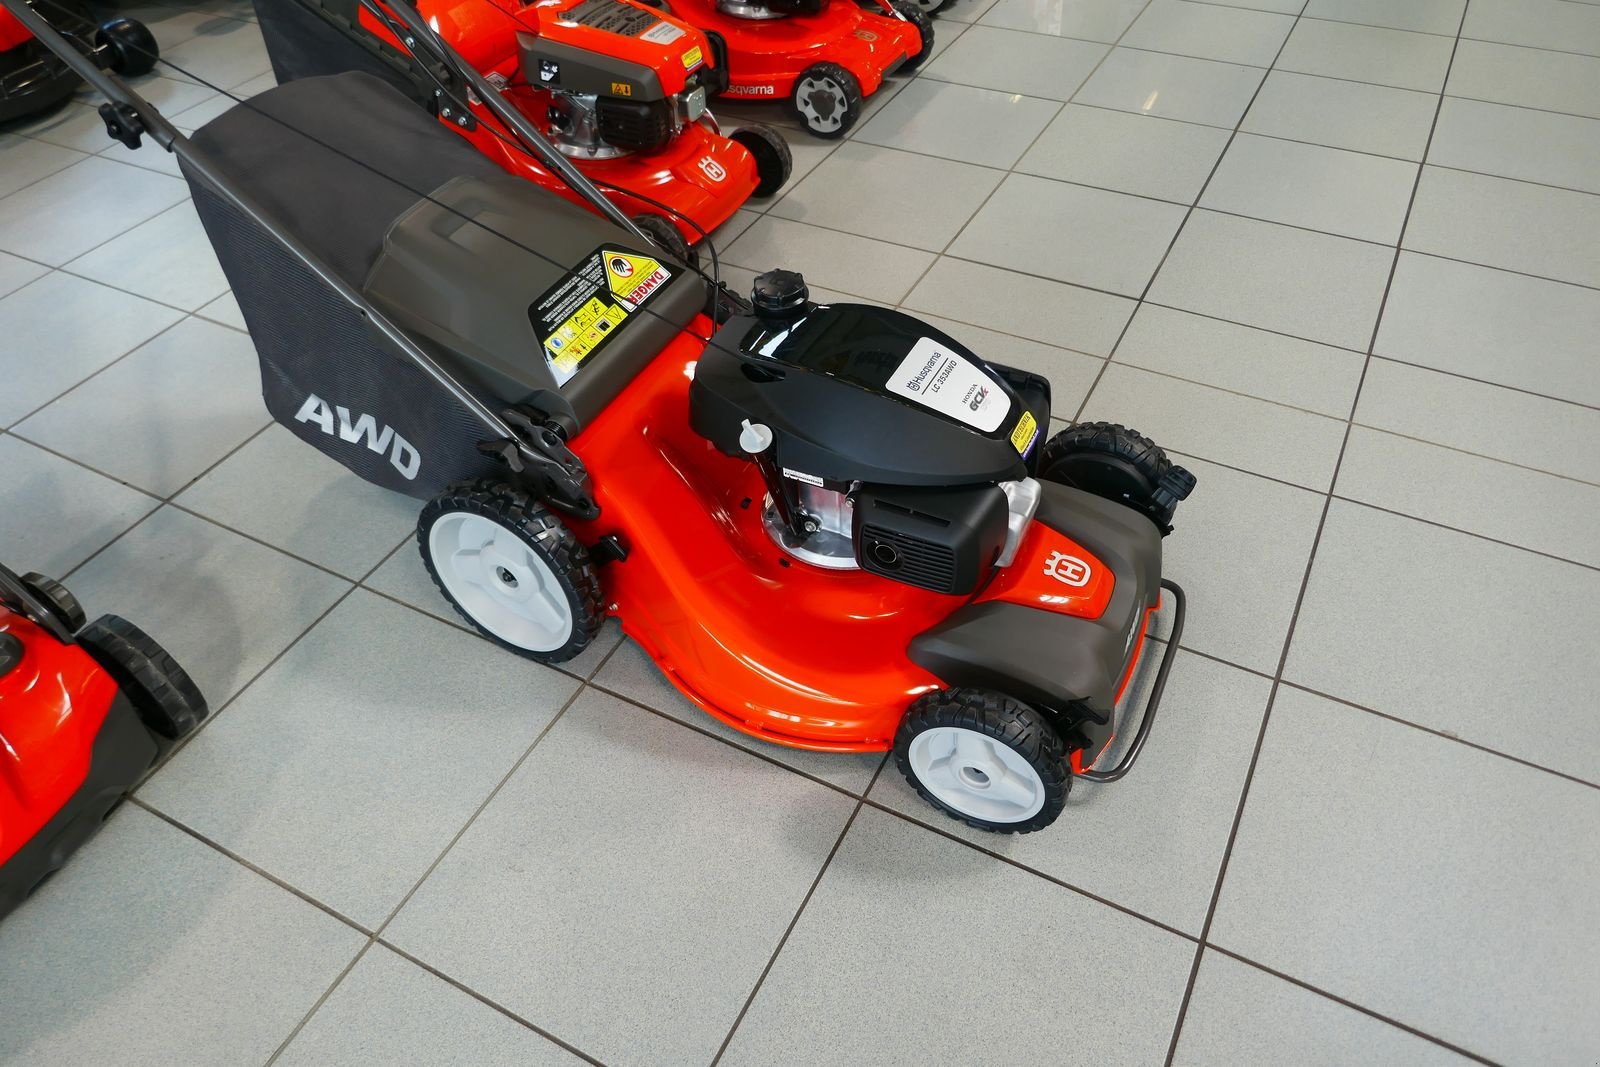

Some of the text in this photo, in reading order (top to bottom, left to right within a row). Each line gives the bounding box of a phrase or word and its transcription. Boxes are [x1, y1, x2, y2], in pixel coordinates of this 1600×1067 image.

[727, 85, 774, 95] sqvarna
[626, 271, 665, 305] DANGER
[912, 352, 942, 385] Husqvarna
[931, 360, 957, 393] LC 353AWD
[962, 384, 978, 404] HONDA
[294, 393, 421, 480] AWD
